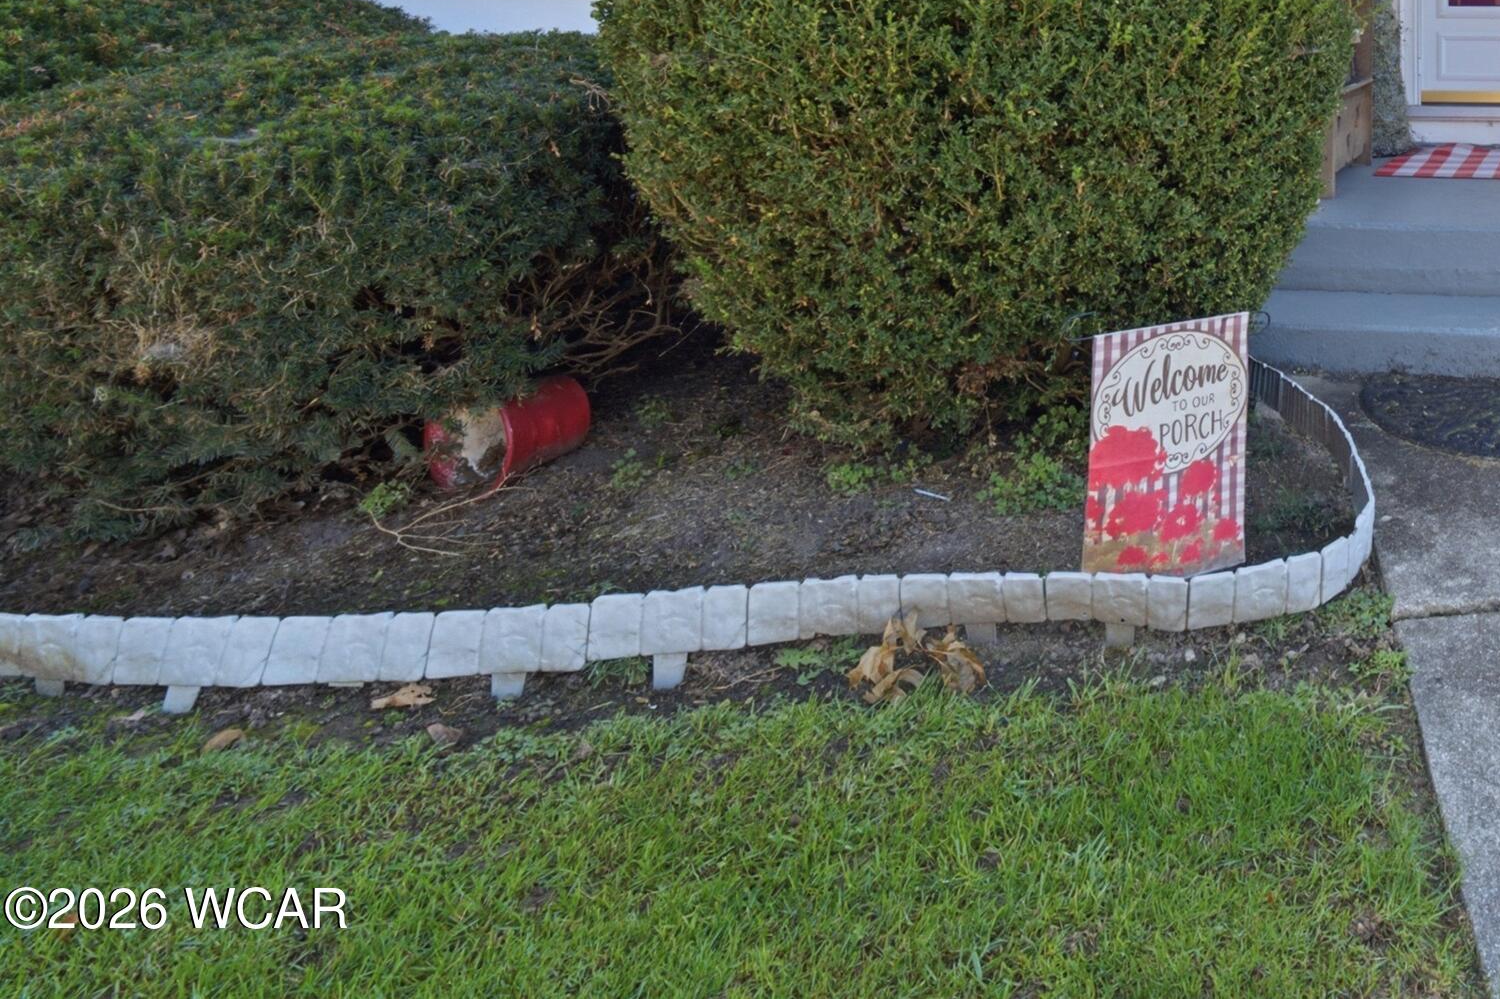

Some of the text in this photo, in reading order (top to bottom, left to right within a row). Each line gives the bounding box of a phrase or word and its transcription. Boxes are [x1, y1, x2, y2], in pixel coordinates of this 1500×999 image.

[1111, 353, 1229, 417] Welcome
[1172, 393, 1215, 412] TO OUR
[1160, 409, 1223, 449] PORCH
